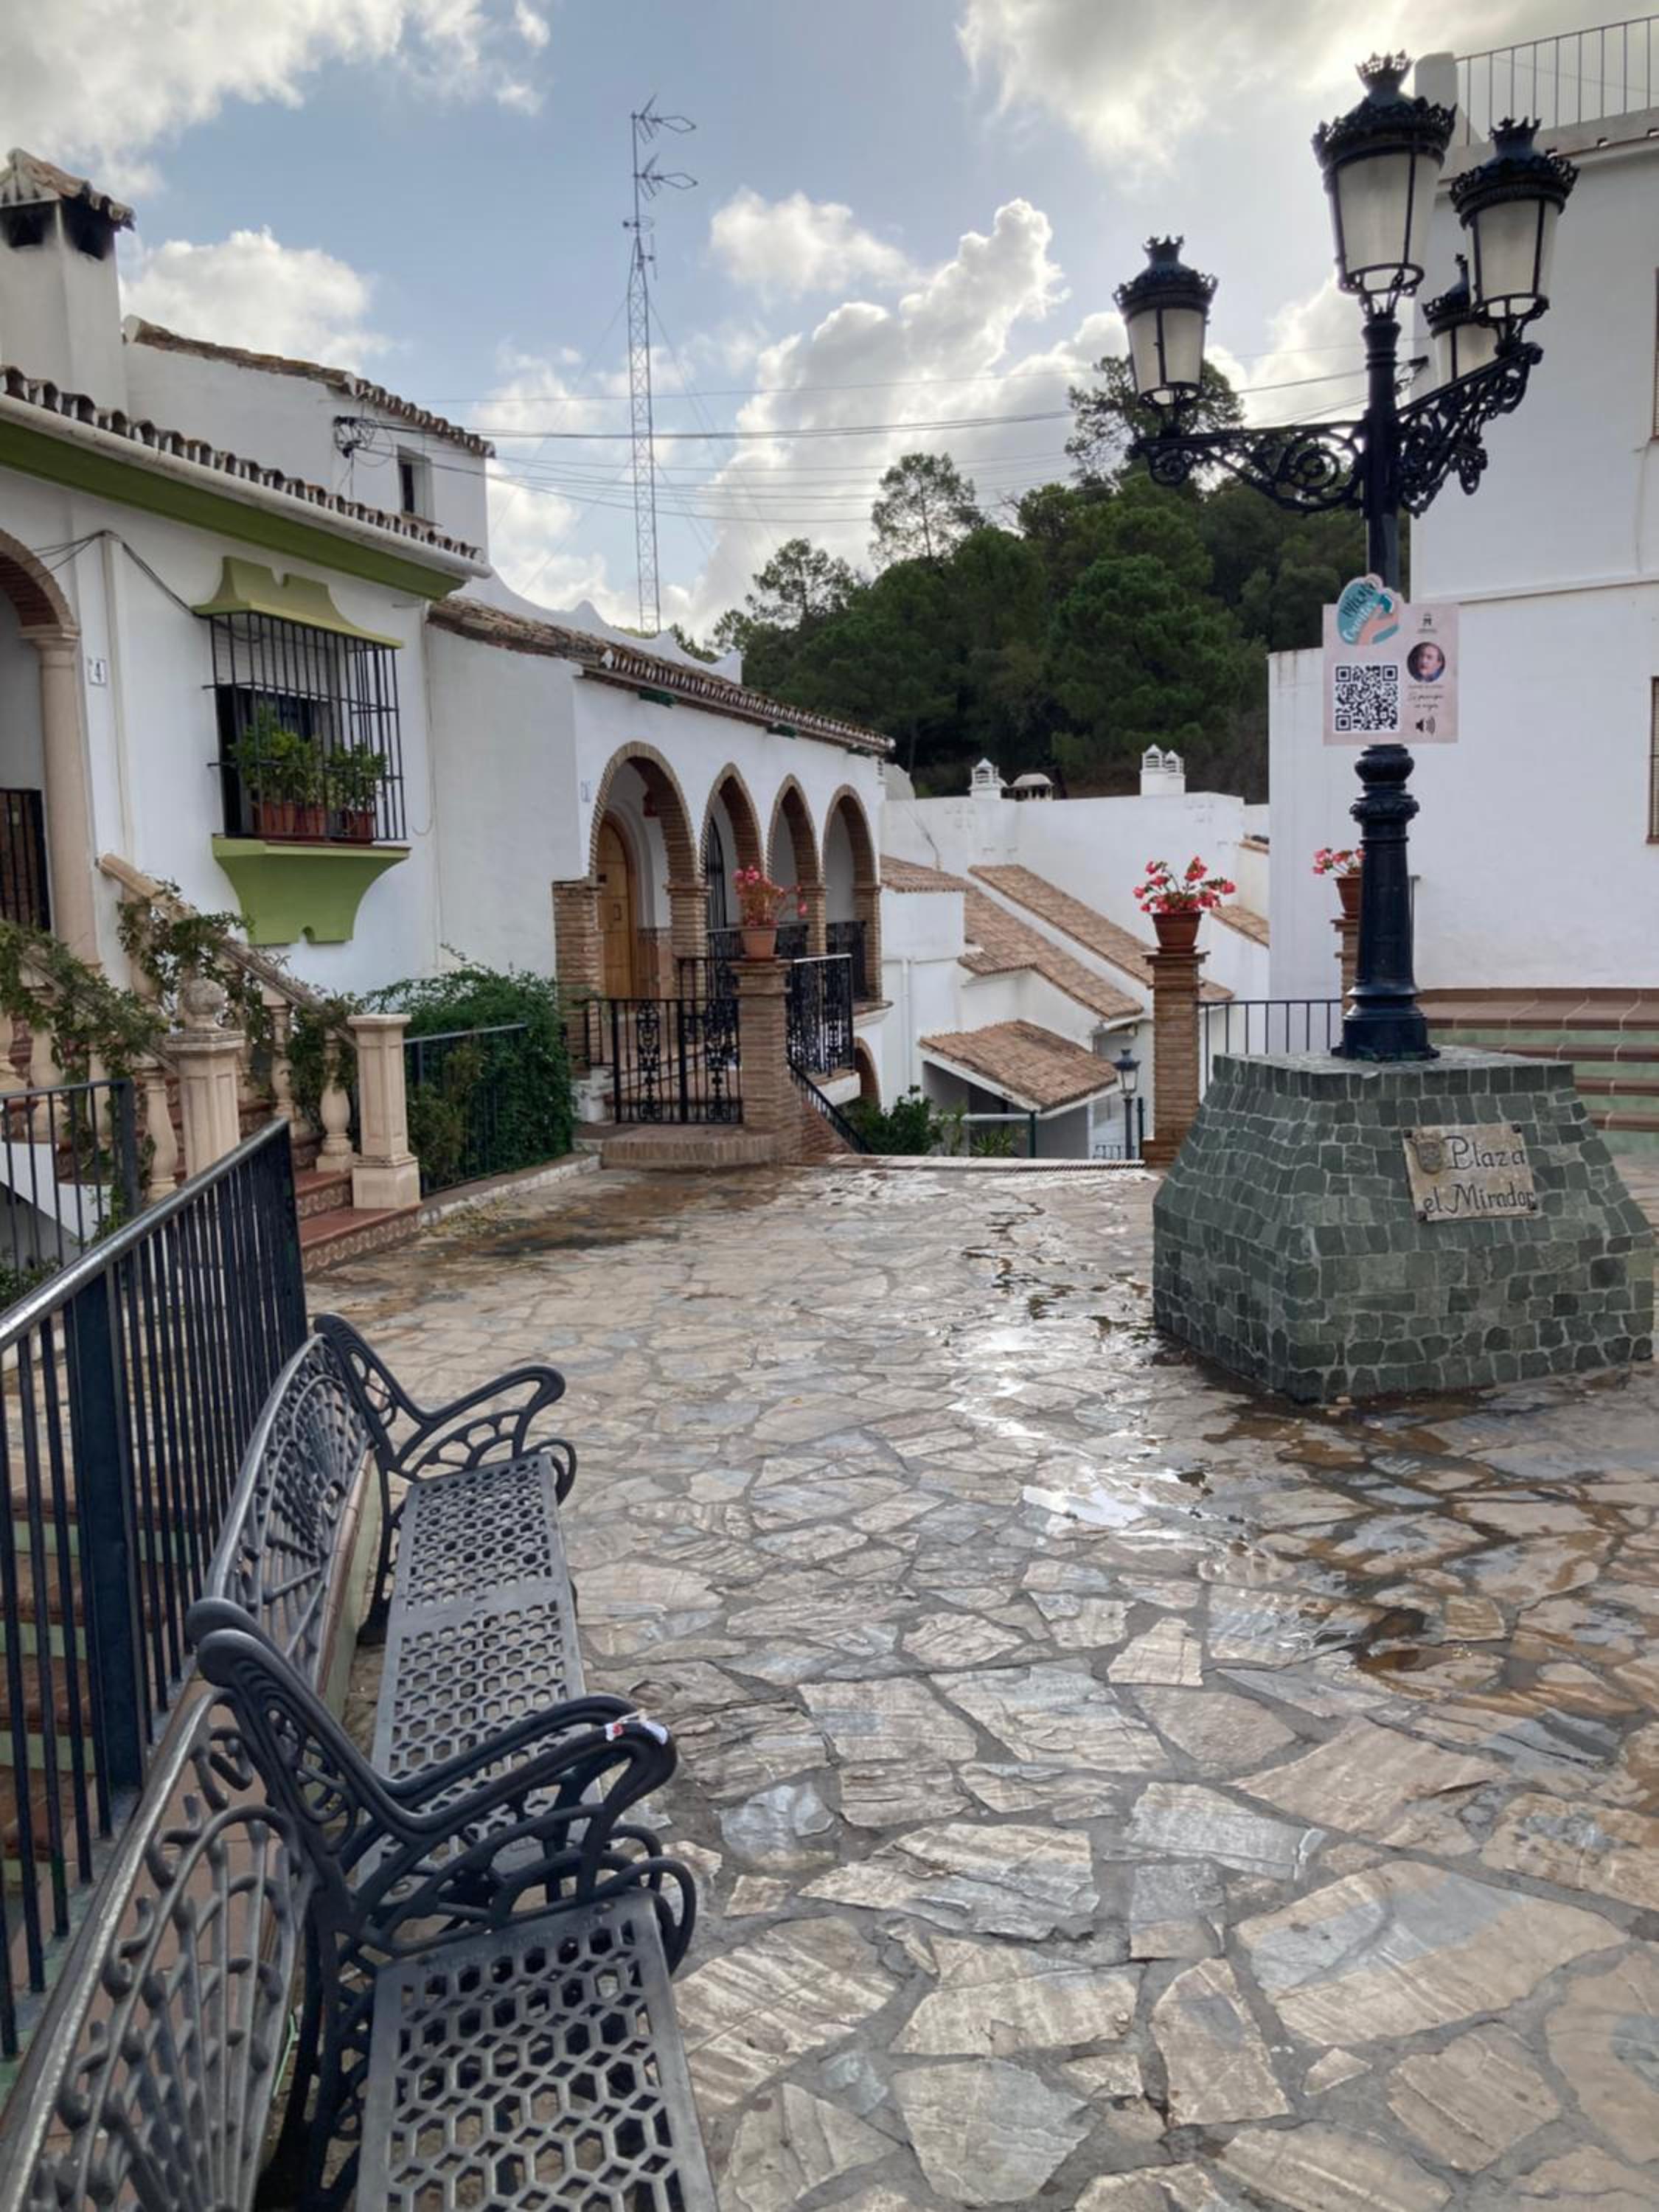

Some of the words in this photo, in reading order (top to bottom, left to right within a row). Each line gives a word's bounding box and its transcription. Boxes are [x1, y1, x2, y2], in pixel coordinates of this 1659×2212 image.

[1441, 1135, 1526, 1170] Plaza
[1423, 1186, 1442, 1214] el
[1444, 1181, 1534, 1214] Mirador
